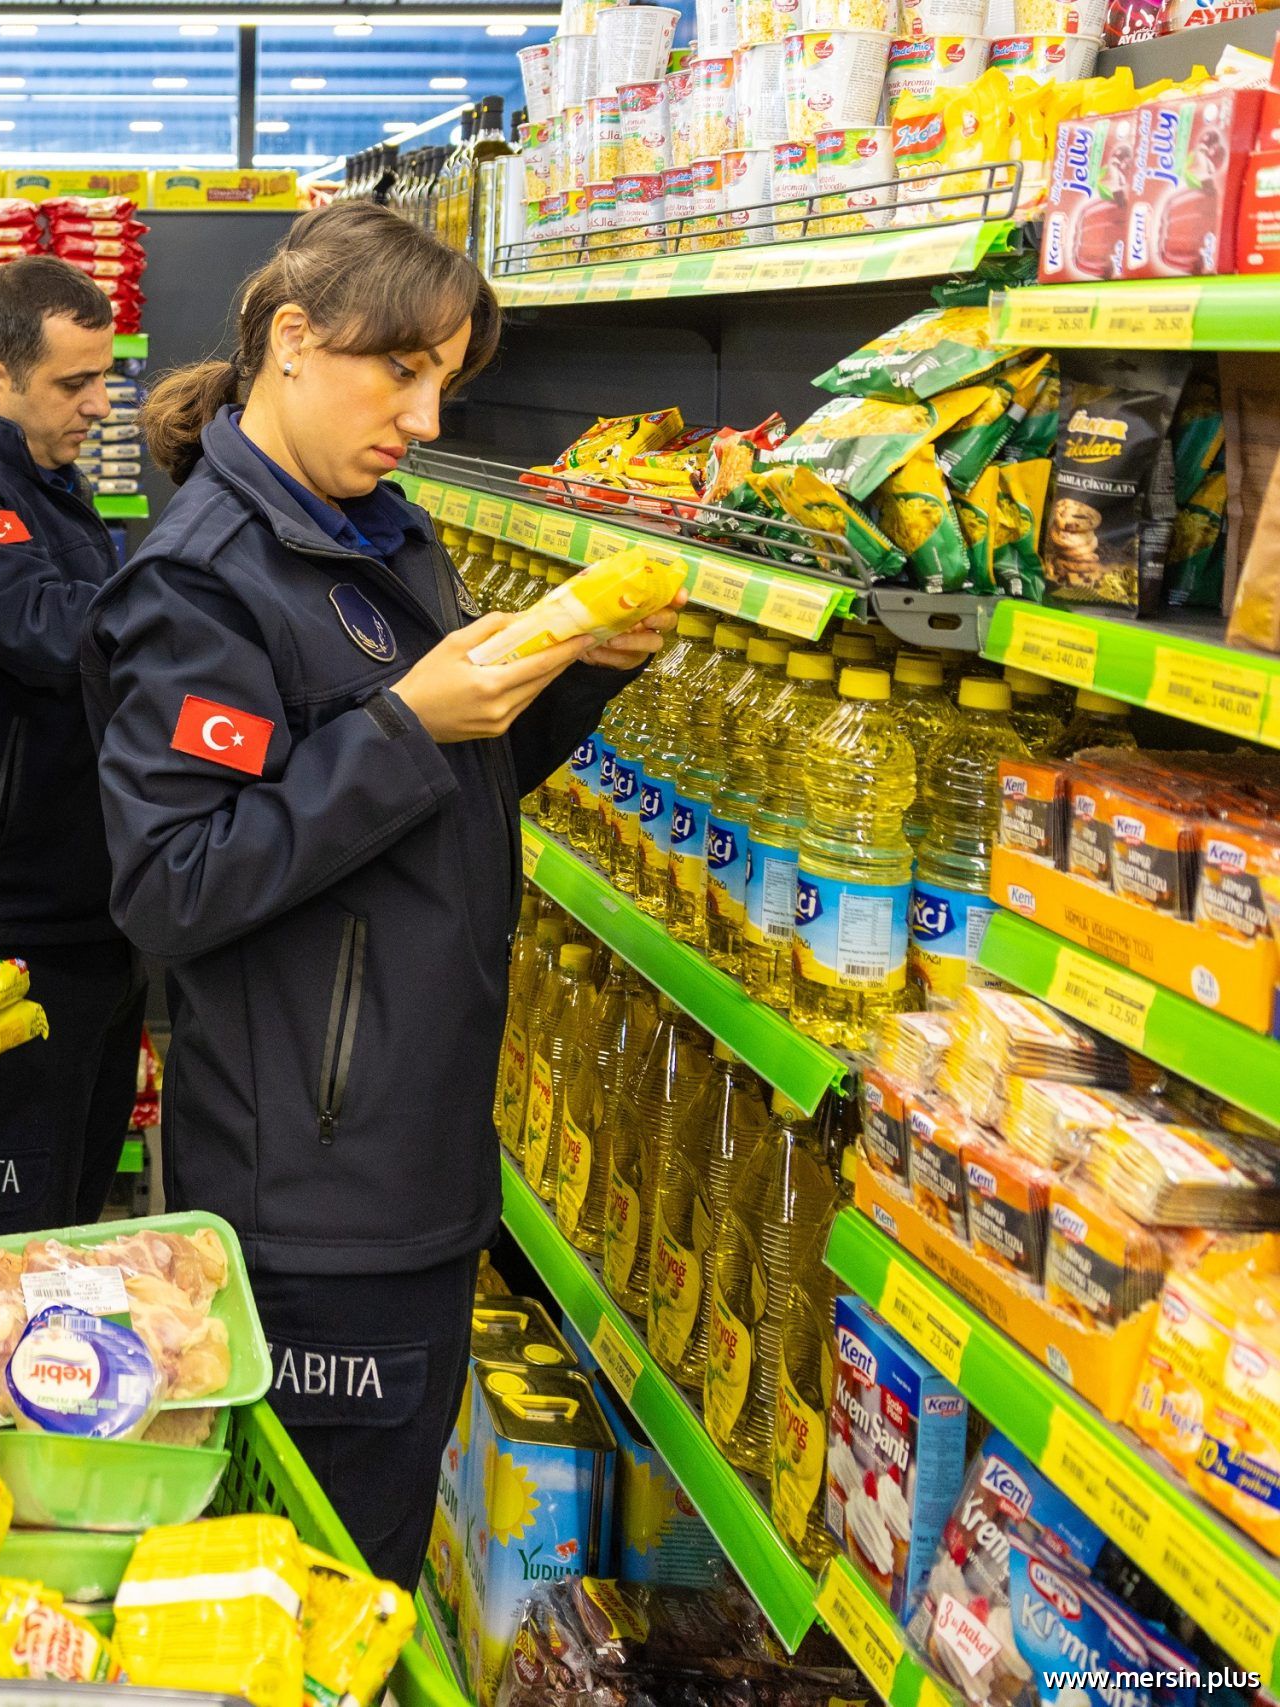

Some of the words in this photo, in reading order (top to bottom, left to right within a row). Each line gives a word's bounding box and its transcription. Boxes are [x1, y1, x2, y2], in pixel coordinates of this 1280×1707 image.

[1118, 31, 1156, 46] AYLUX
[1063, 127, 1096, 199] jelly
[1149, 111, 1179, 188] jelly
[1047, 220, 1061, 267] Kent
[1130, 211, 1145, 261] Kent
[1081, 477, 1136, 495] ÇİKOLATA
[1004, 777, 1026, 793] Kent
[1116, 818, 1143, 836] Kent
[1209, 842, 1246, 864] Kent
[1010, 888, 1034, 906] Kent
[1108, 999, 1138, 1026] 12,50
[912, 1112, 933, 1136] Kent
[970, 1166, 995, 1190] Kent
[874, 1205, 896, 1231] Kent
[1054, 1206, 1085, 1237] Kent
[840, 1333, 874, 1376] Kent
[929, 1331, 956, 1363] 23,50
[30, 1363, 92, 1388] kebir
[265, 1343, 384, 1399] ABITA
[835, 1373, 870, 1434] Krem
[927, 1397, 962, 1412] Kent
[985, 1463, 1029, 1515] Kent
[516, 1541, 581, 1581] YUDUM
